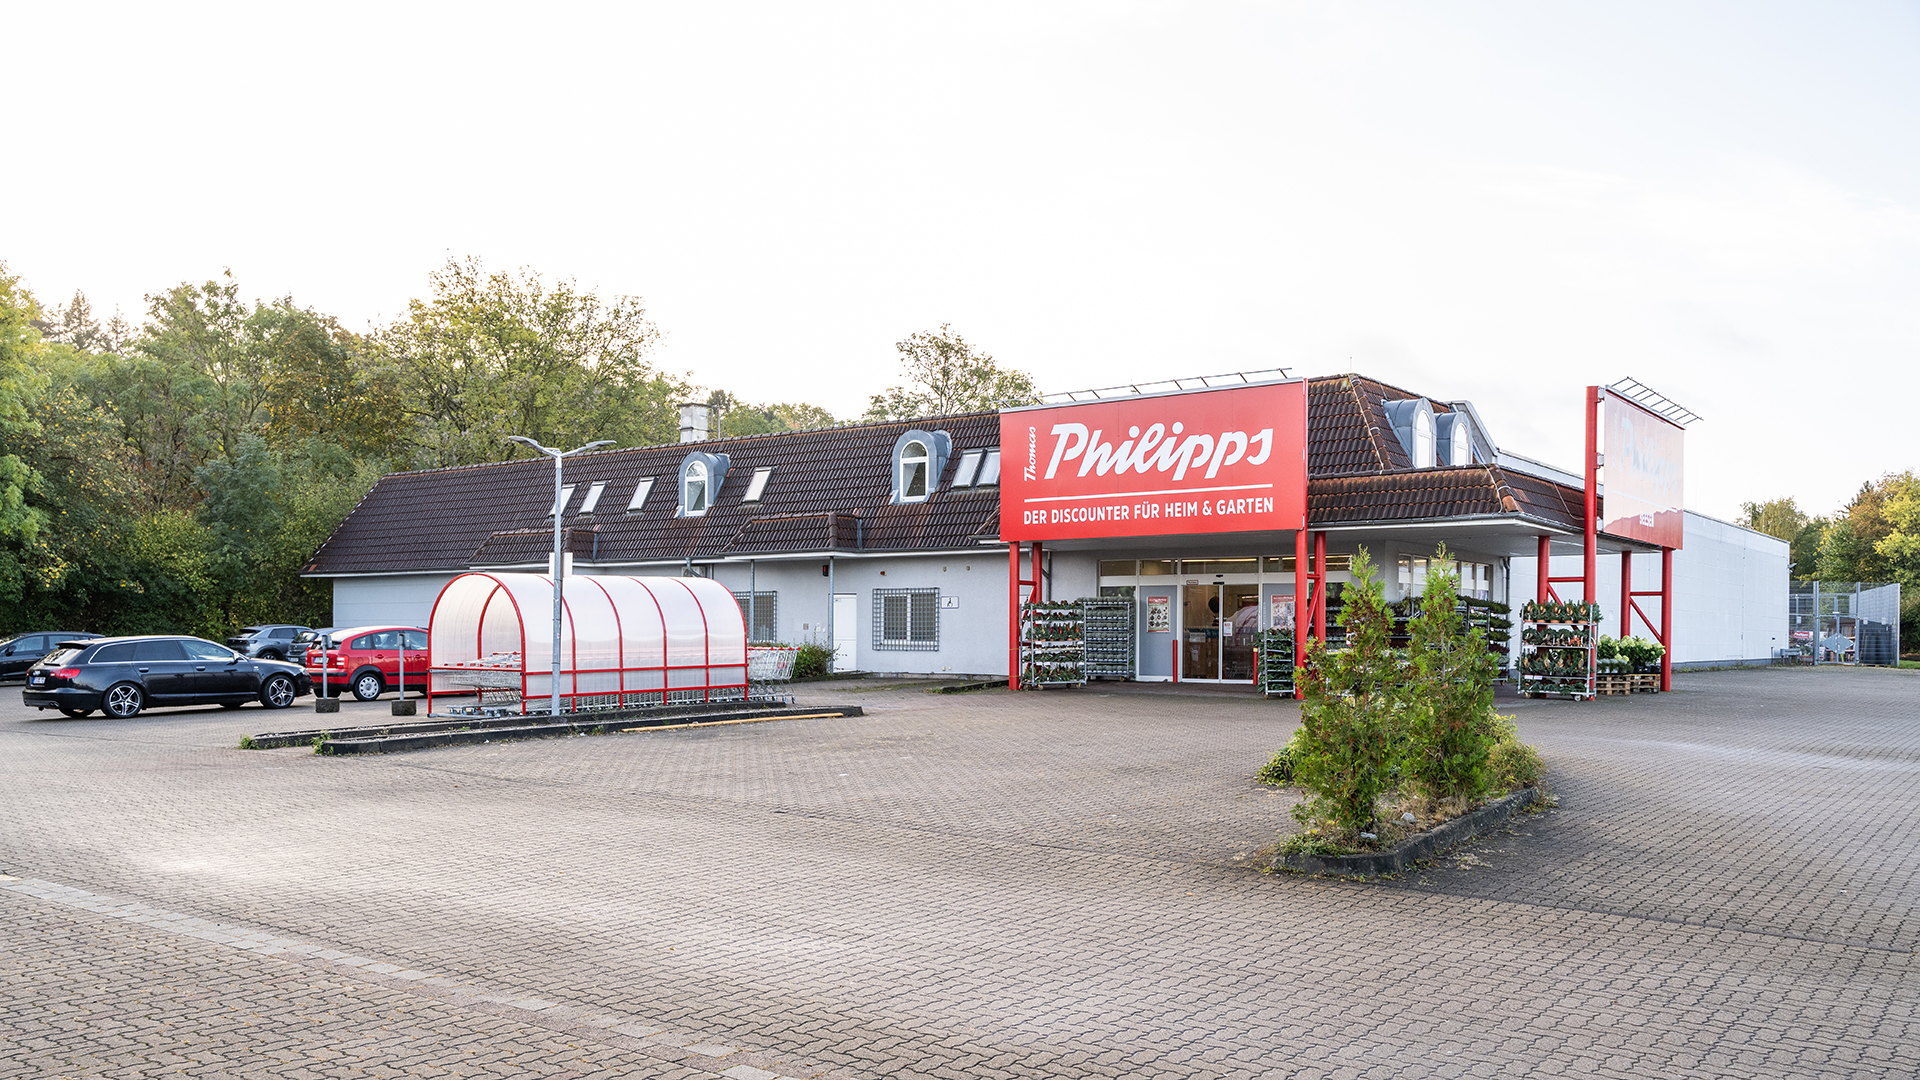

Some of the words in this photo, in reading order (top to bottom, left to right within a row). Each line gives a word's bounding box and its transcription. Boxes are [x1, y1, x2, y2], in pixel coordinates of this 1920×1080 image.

[1023, 426, 1036, 482] Thomas
[1043, 421, 1274, 481] Philipps
[1023, 509, 1047, 525] DER
[1051, 504, 1130, 524] DISCOUNTER
[1133, 501, 1160, 520] FÜR
[1164, 501, 1198, 518] HEIM
[1202, 500, 1213, 516] &
[1216, 496, 1274, 515] GARTEN
